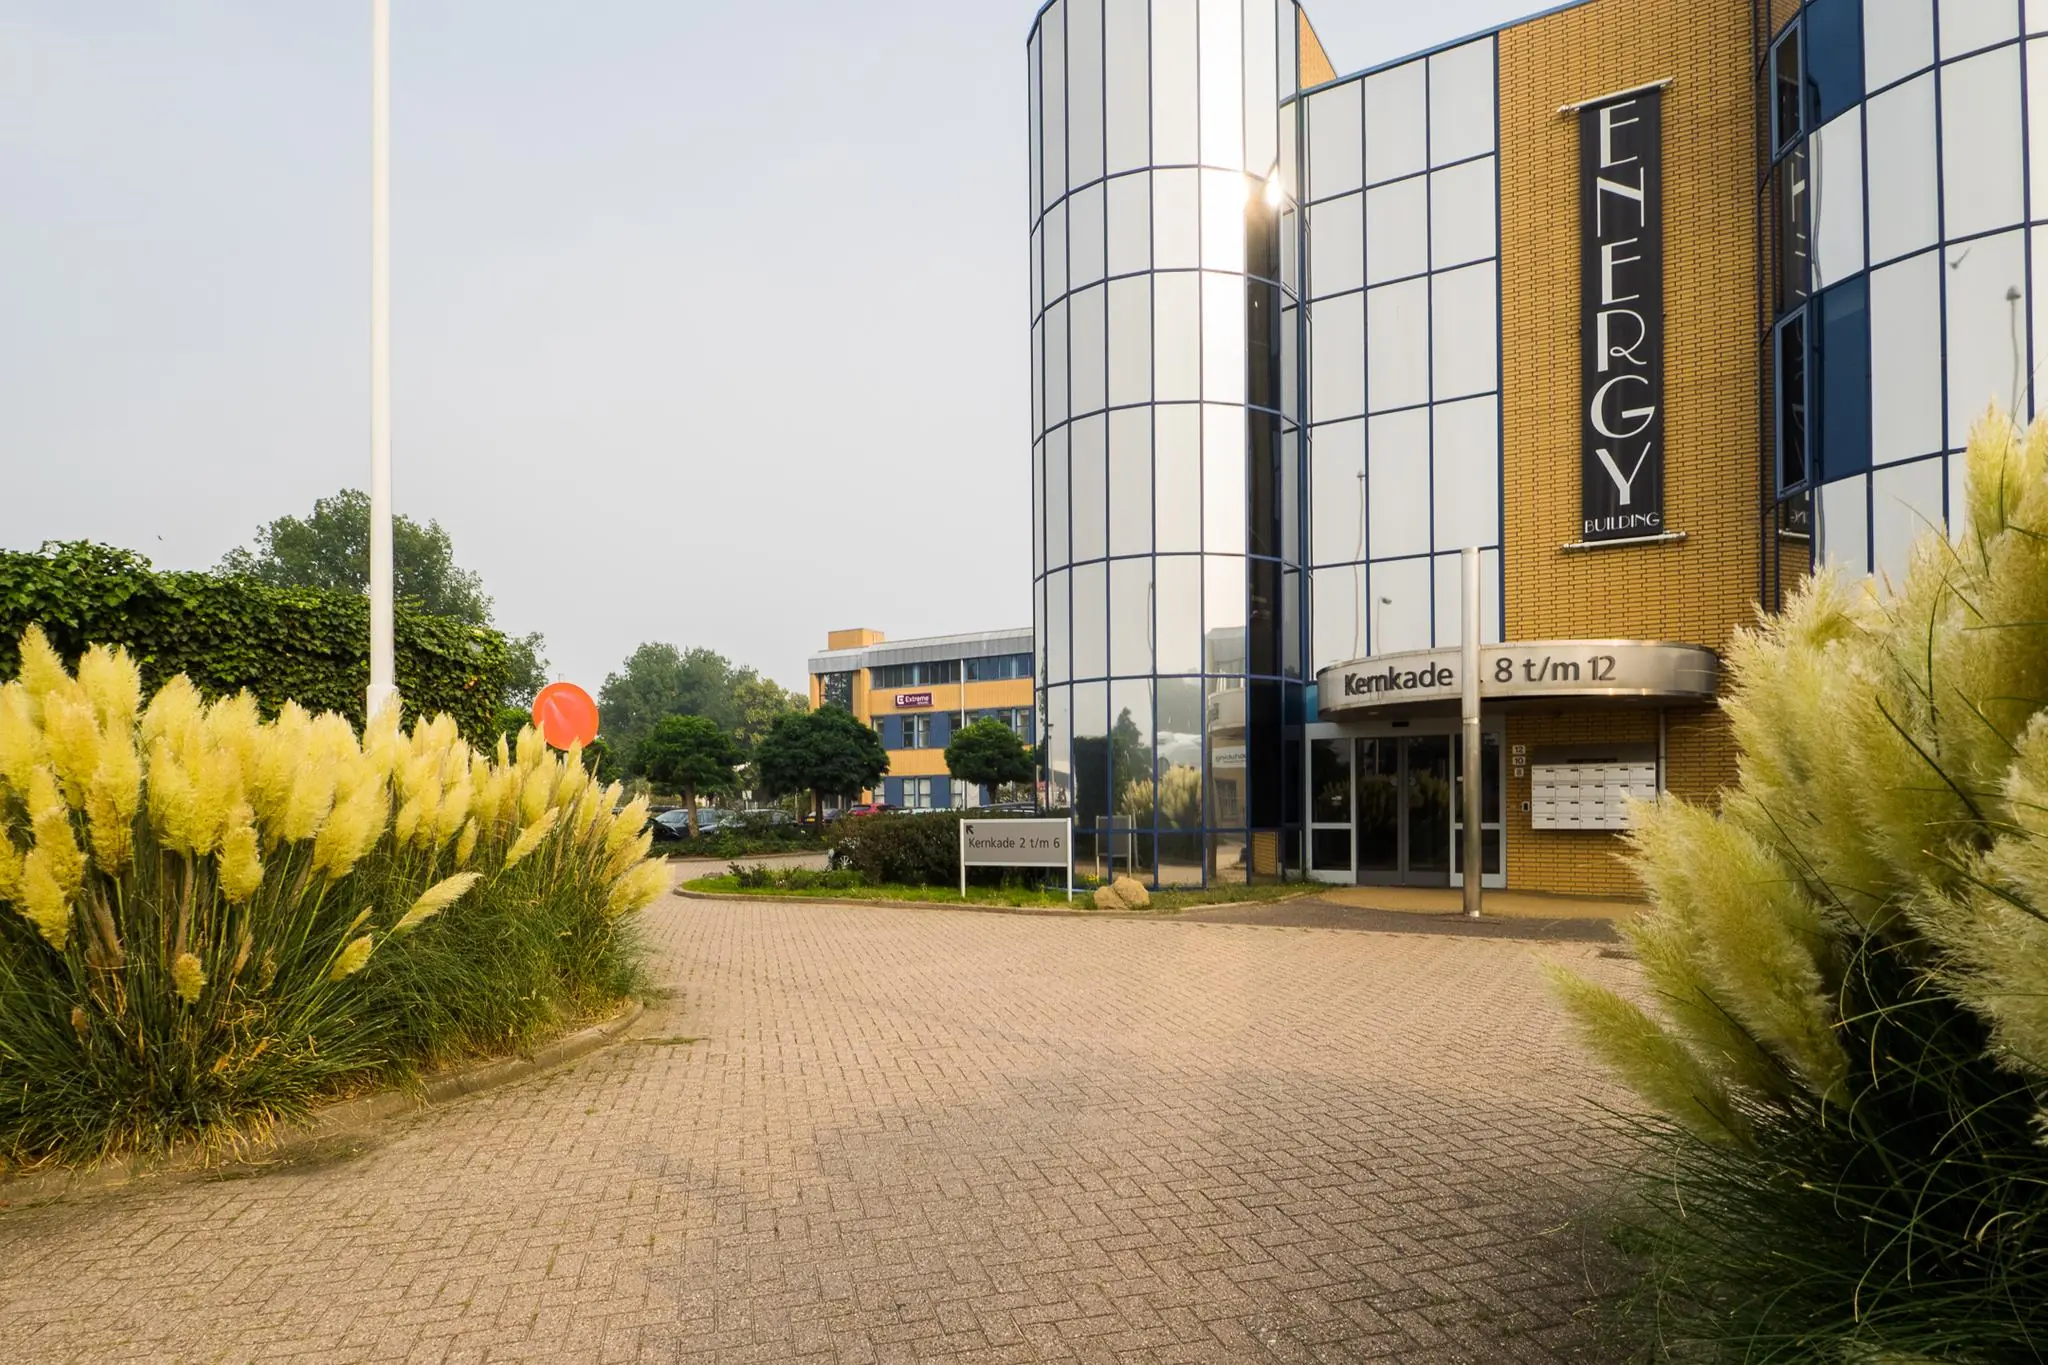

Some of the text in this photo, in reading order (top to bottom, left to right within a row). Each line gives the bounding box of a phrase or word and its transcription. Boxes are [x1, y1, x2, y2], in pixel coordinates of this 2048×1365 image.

[1591, 100, 1656, 506] ENERGY
[1584, 511, 1660, 534] BUILDING
[1344, 655, 1616, 696] Kernkade 8 t/m 12
[968, 836, 1060, 849] Kernkade 2 t/m 6
